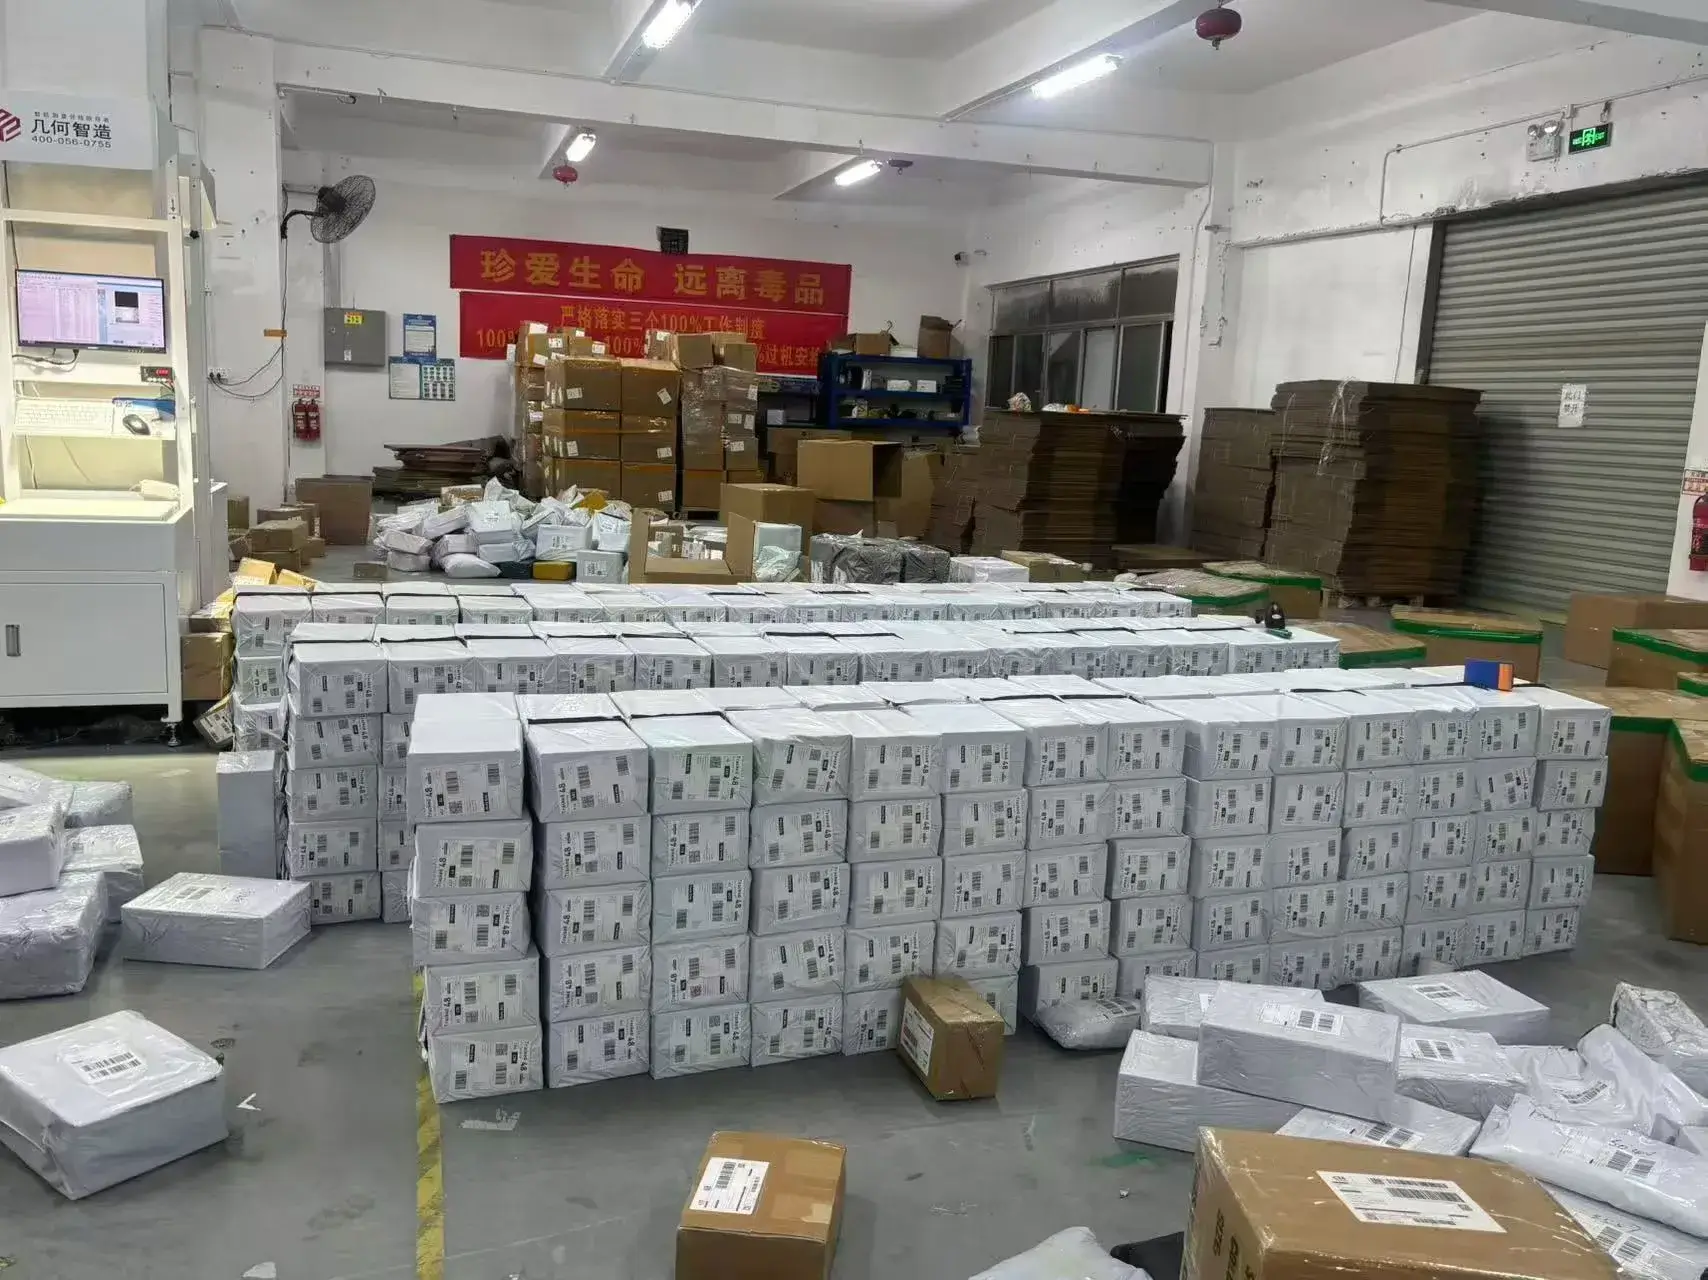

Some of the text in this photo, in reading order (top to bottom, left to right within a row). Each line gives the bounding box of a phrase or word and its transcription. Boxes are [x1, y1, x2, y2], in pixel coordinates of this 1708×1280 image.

[31, 119, 112, 140] 几何智造
[31, 135, 112, 149] 400-056-0755
[480, 247, 825, 307] 珍爱生命 远离毒品
[922, 764, 929, 774] 48
[558, 783, 566, 792] 48
[564, 847, 571, 856] 48
[438, 858, 446, 868] 48
[832, 886, 840, 896] 48
[502, 925, 510, 936] 48
